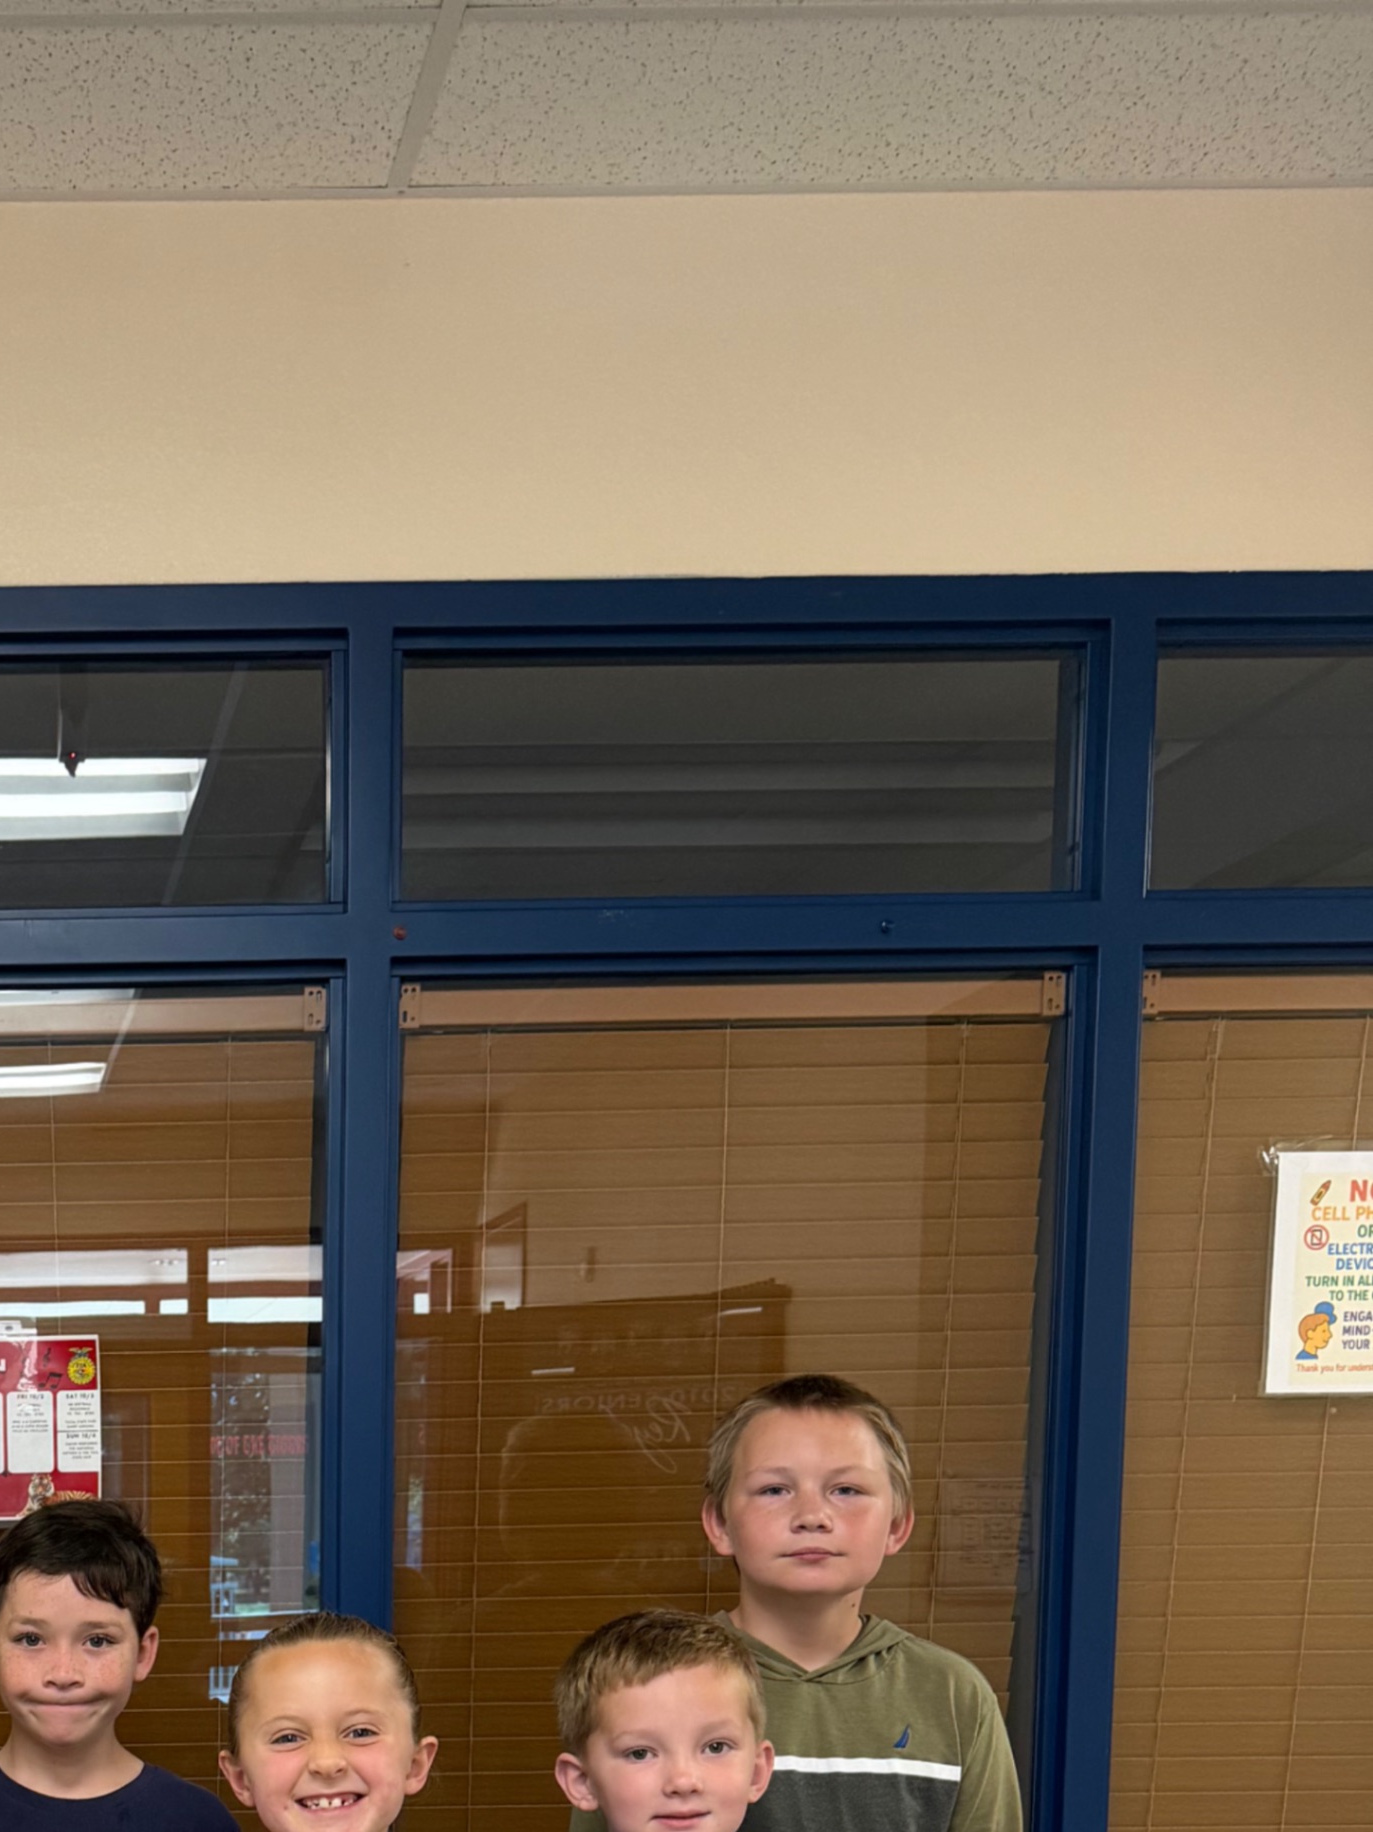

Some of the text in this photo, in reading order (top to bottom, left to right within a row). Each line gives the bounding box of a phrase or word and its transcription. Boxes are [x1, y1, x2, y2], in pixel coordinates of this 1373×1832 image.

[1350, 1179, 1373, 1203] N
[1311, 1205, 1373, 1221] CELL PH
[1327, 1243, 1373, 1256] ELECTR
[1336, 1258, 1373, 1271] DEVIC
[1305, 1276, 1339, 1287] TURN
[1343, 1275, 1355, 1287] IN
[1330, 1289, 1369, 1301] TO THE
[1343, 1311, 1373, 1323] ENGA
[1341, 1339, 1370, 1350] YOUR
[1296, 1363, 1318, 1372] Thank
[1321, 1365, 1335, 1374] you
[1336, 1362, 1347, 1372] for
